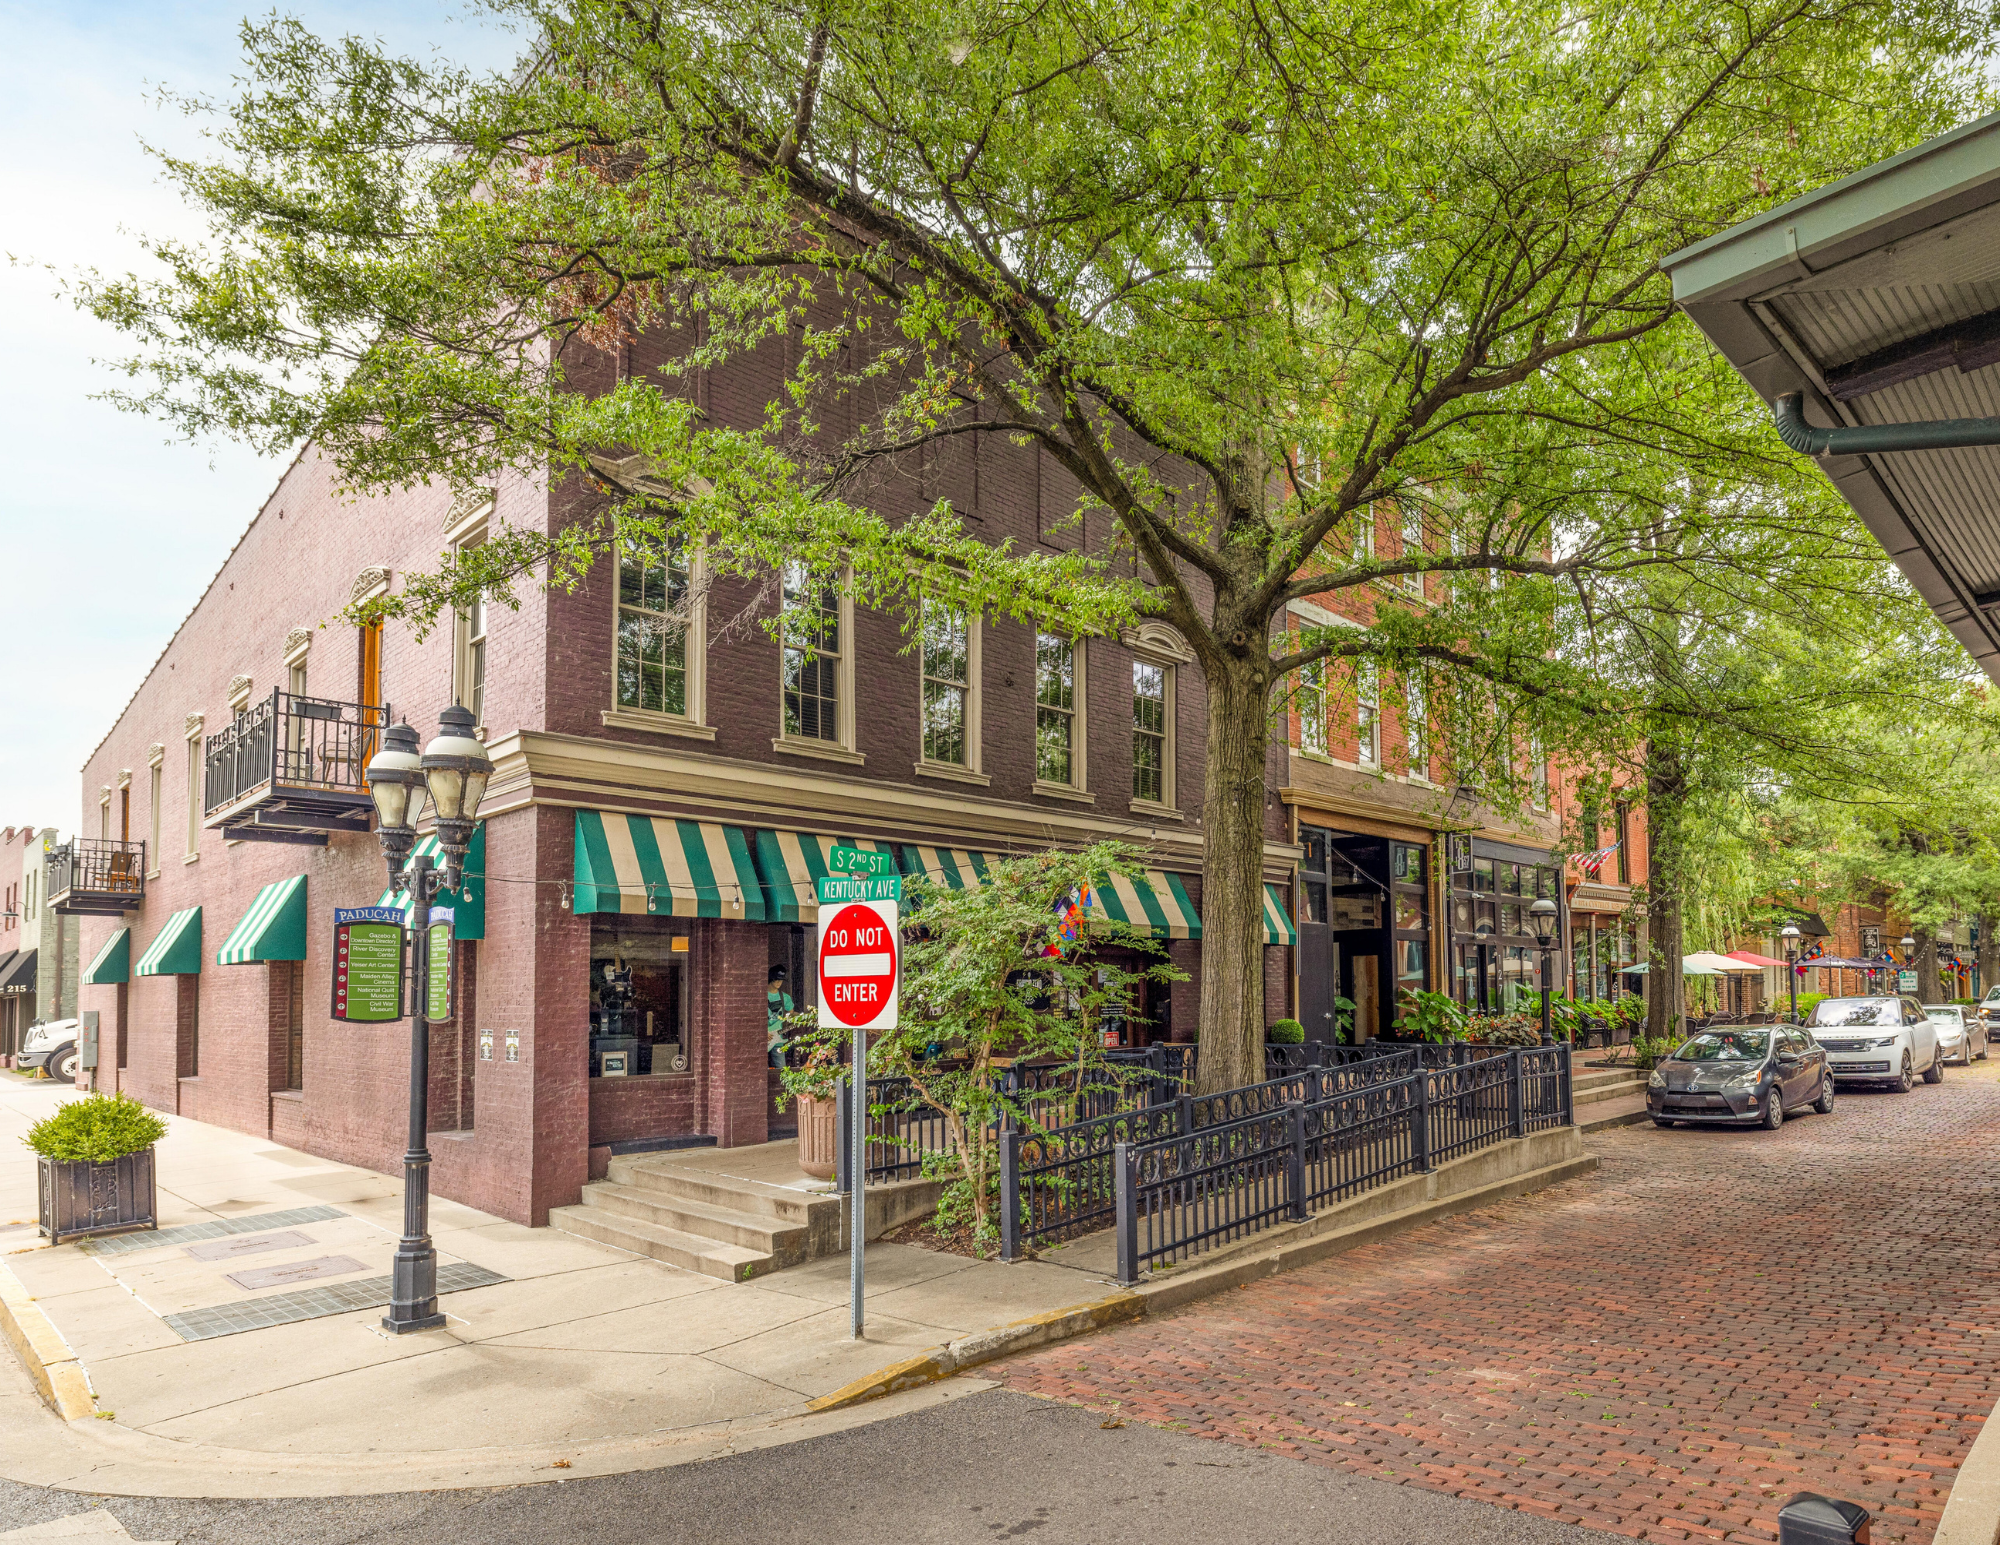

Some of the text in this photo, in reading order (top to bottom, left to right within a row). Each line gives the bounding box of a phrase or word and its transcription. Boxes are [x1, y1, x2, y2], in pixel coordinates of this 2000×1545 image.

[836, 850, 883, 873] S 2ND ST
[824, 879, 895, 899] KENTUCKY AVE
[338, 909, 402, 921] PADUCAH
[829, 927, 884, 949] DO NOT
[7, 984, 27, 993] 215
[834, 983, 878, 1002] ENTER
